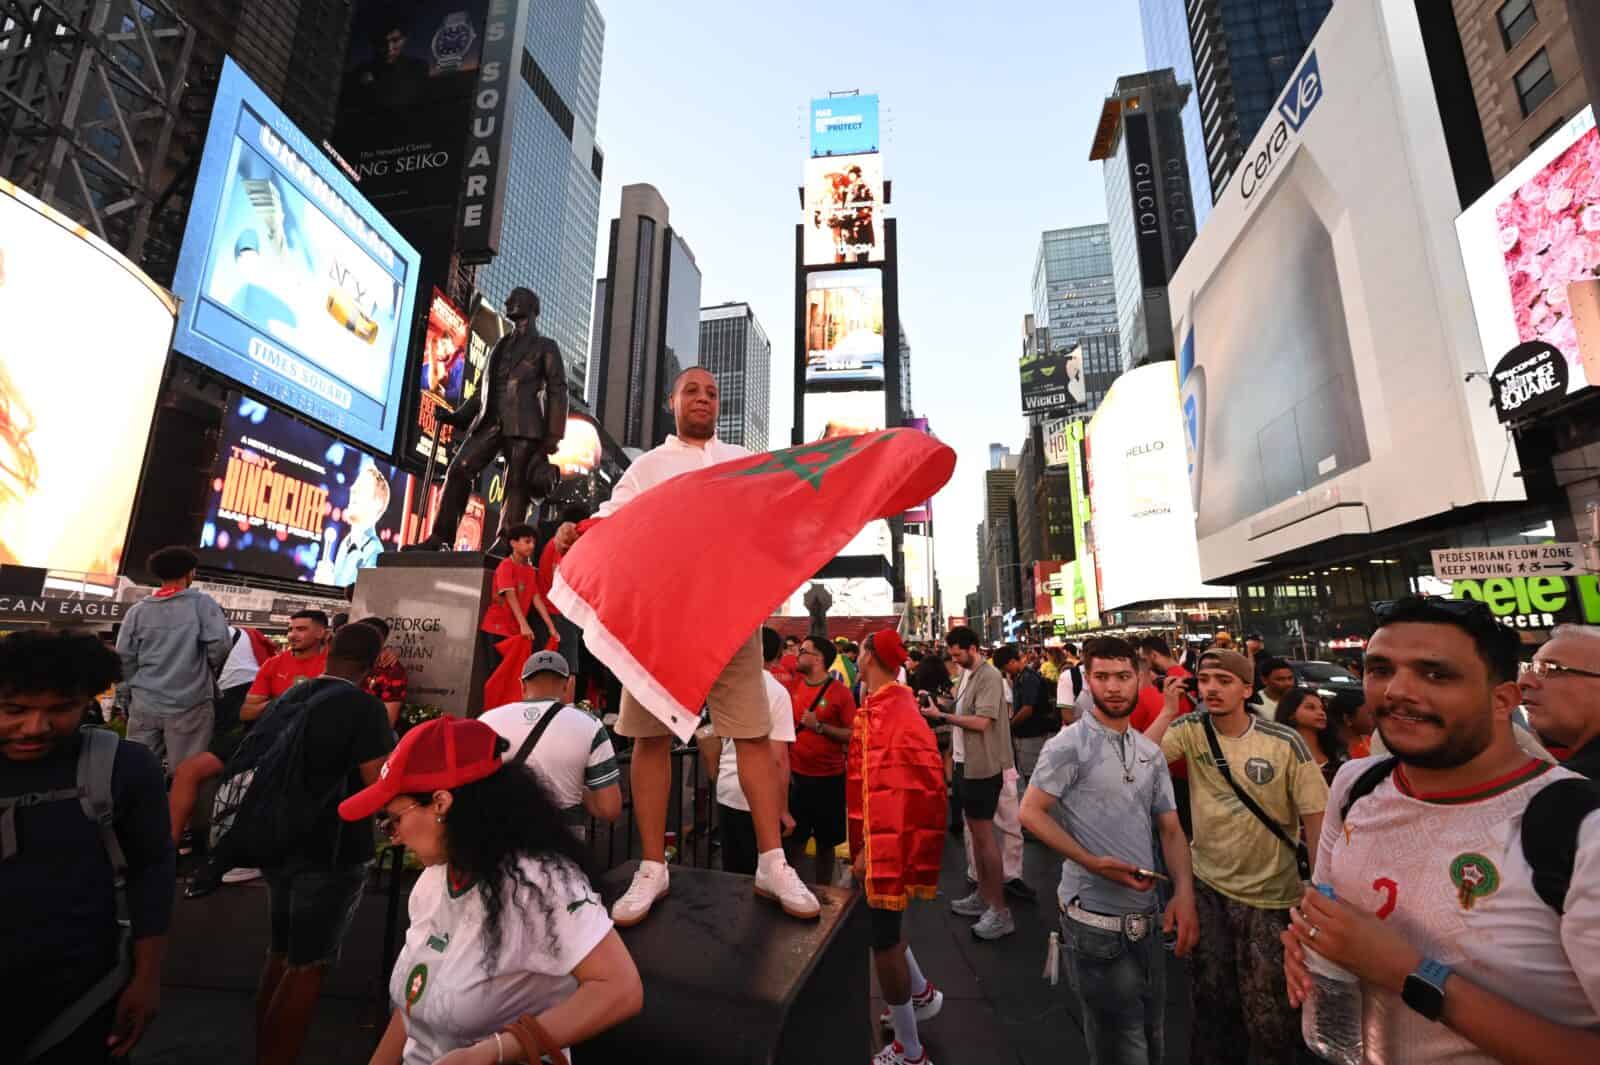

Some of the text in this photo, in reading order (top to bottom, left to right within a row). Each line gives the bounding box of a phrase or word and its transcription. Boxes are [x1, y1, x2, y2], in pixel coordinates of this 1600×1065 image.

[463, 61, 500, 227] SQUARE
[396, 152, 448, 173] SEIKO
[1134, 163, 1157, 235] GUCCI
[254, 341, 297, 378] TIMES
[1501, 376, 1561, 410] SQUARE
[231, 445, 277, 469] TONY
[1126, 441, 1164, 458] HELLO
[1439, 548, 1574, 563] PEDESTRIAN FLOW ZONE
[1440, 563, 1512, 576] KEEP MOVING
[60, 602, 120, 616] EAGLE
[385, 617, 441, 632] GEORGE
